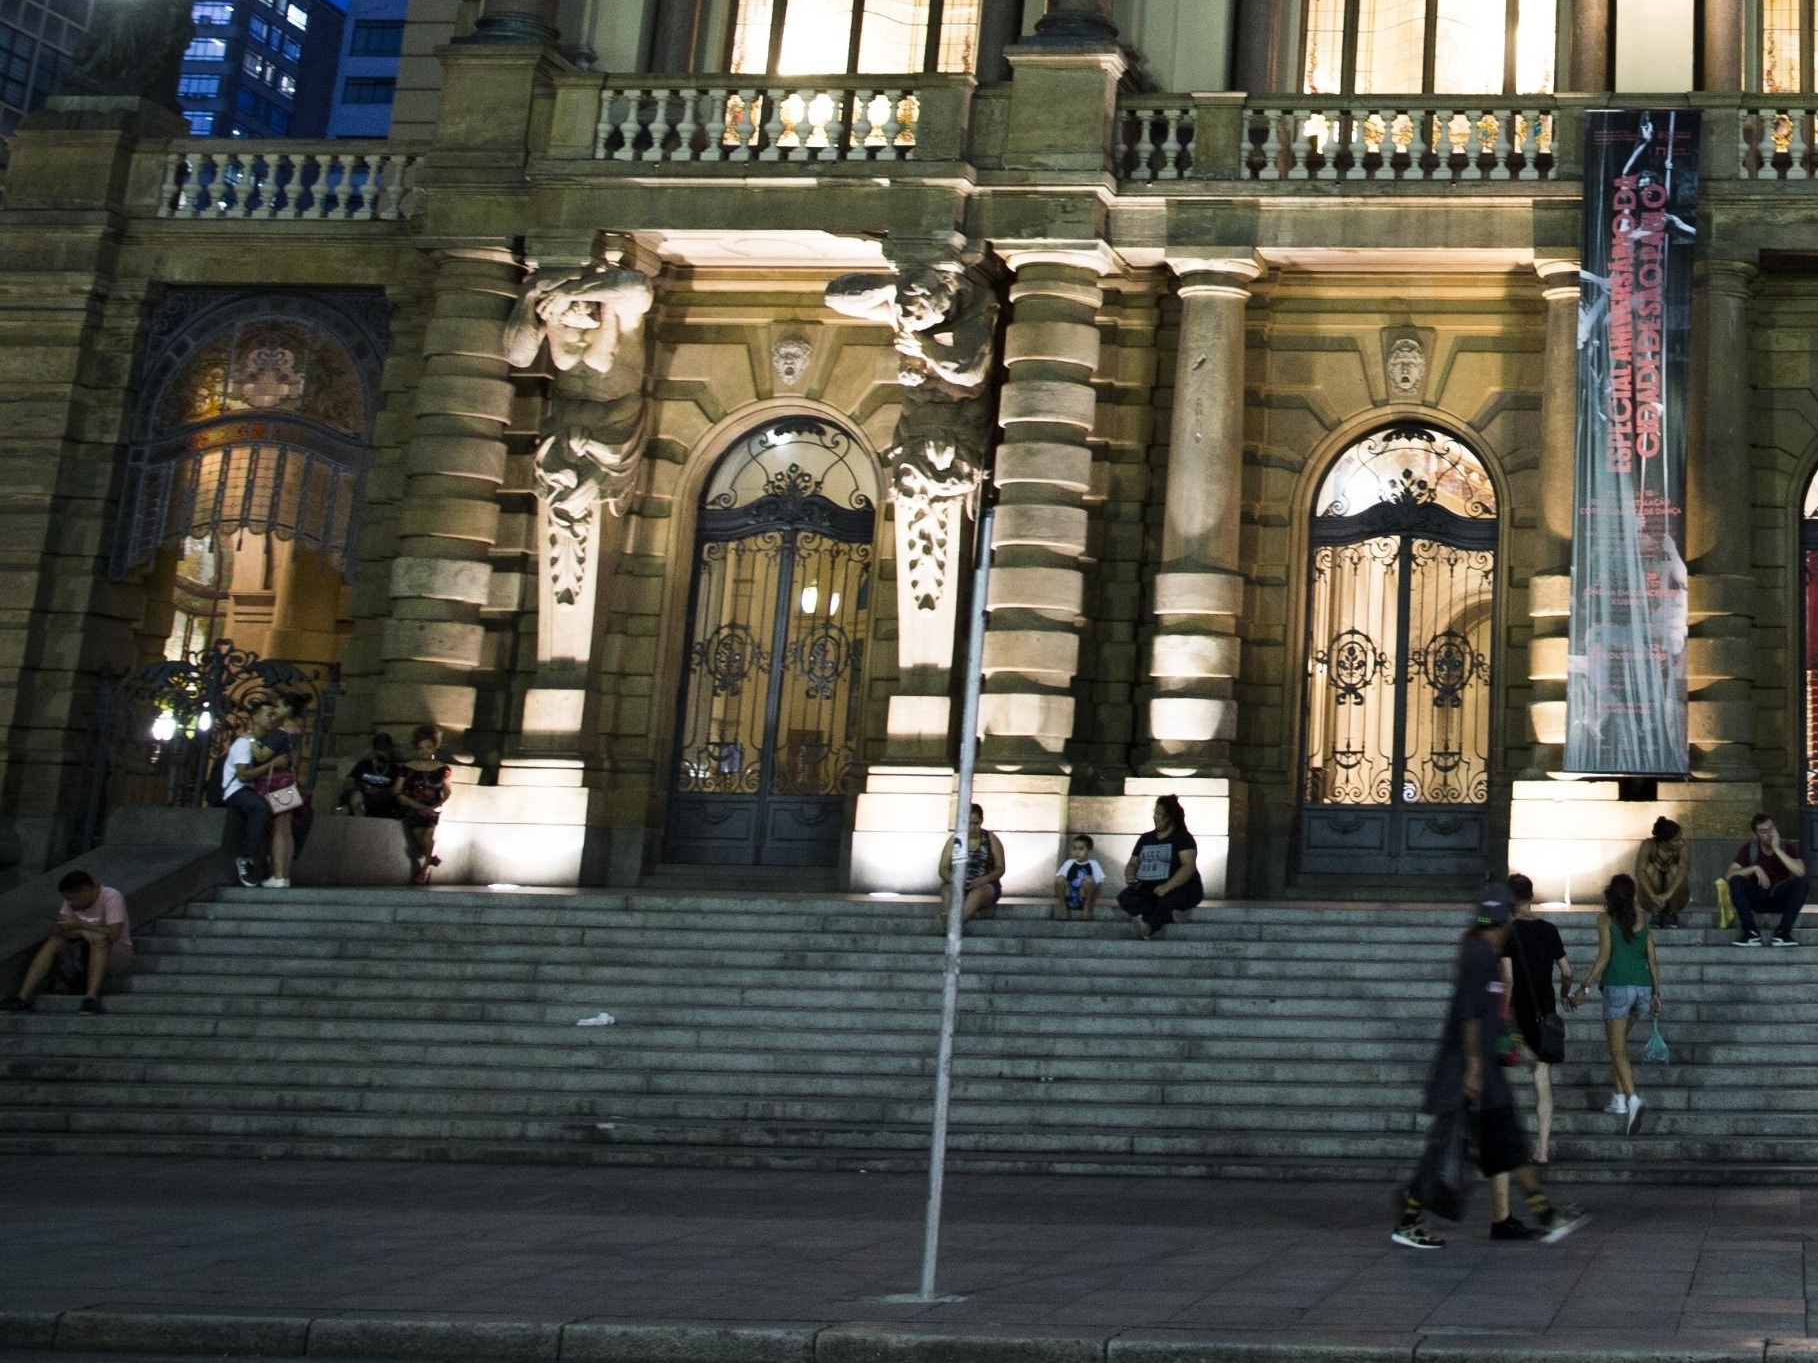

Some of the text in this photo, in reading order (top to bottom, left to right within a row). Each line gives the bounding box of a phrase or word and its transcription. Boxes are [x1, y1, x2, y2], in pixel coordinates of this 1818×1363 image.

[1612, 174, 1639, 210] DA
[1607, 213, 1636, 362] ANIVERSÁRIO
[1634, 183, 1666, 458] CIDADE DE SÃO PAULO
[1606, 364, 1633, 474] ESPECIAL
